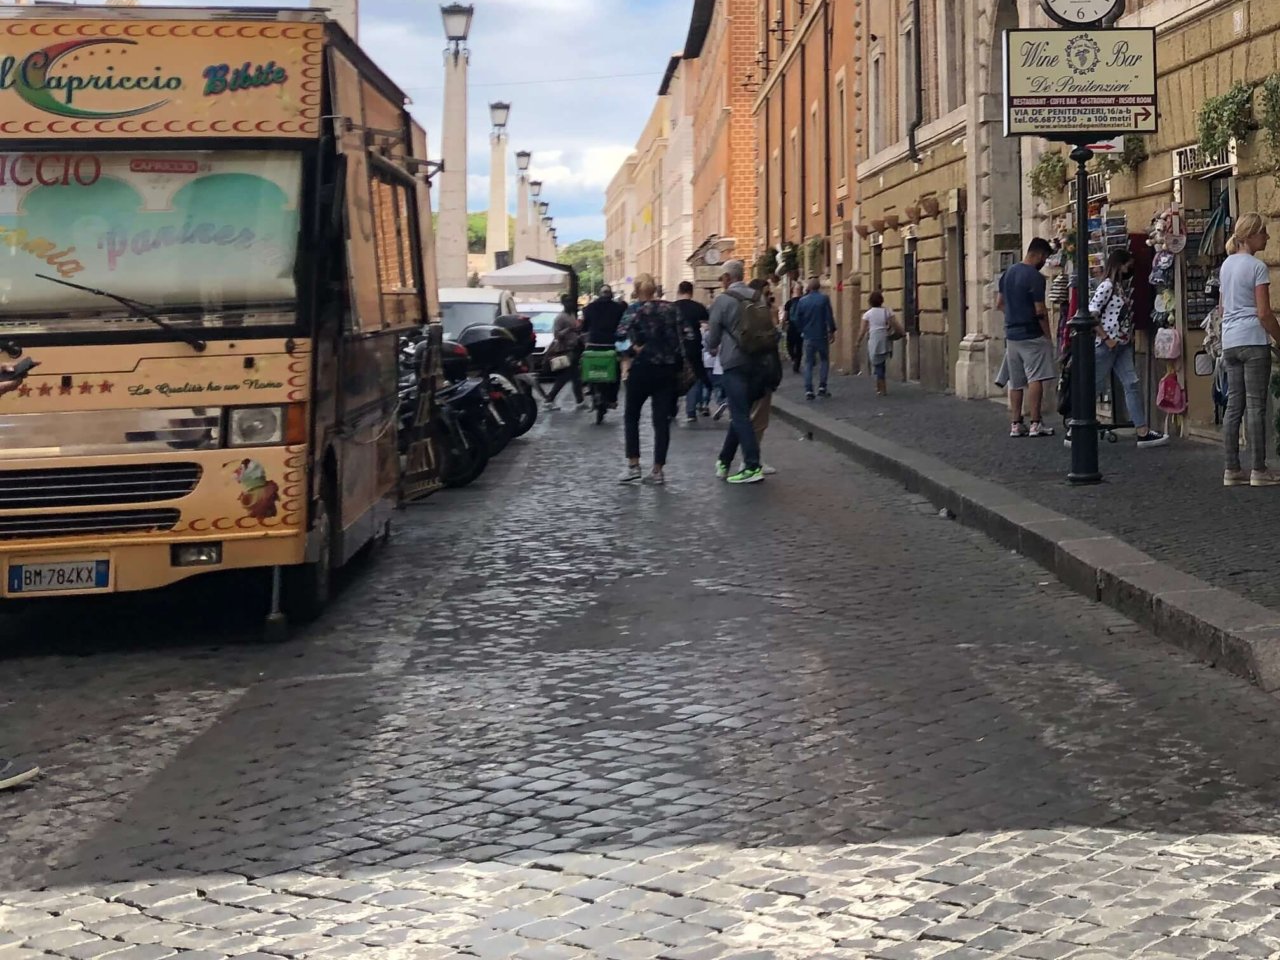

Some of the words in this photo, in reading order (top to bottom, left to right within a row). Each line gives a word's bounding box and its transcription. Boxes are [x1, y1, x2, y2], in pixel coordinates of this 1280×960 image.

[1076, 7, 1085, 20] 6
[1020, 40, 1060, 67] Wine
[1105, 40, 1143, 67] Bar
[21, 50, 183, 104] Capriccio
[202, 60, 289, 97] Bibite
[128, 384, 151, 395] La
[206, 381, 222, 392] ha
[223, 383, 240, 391] un
[243, 379, 284, 389] Nome
